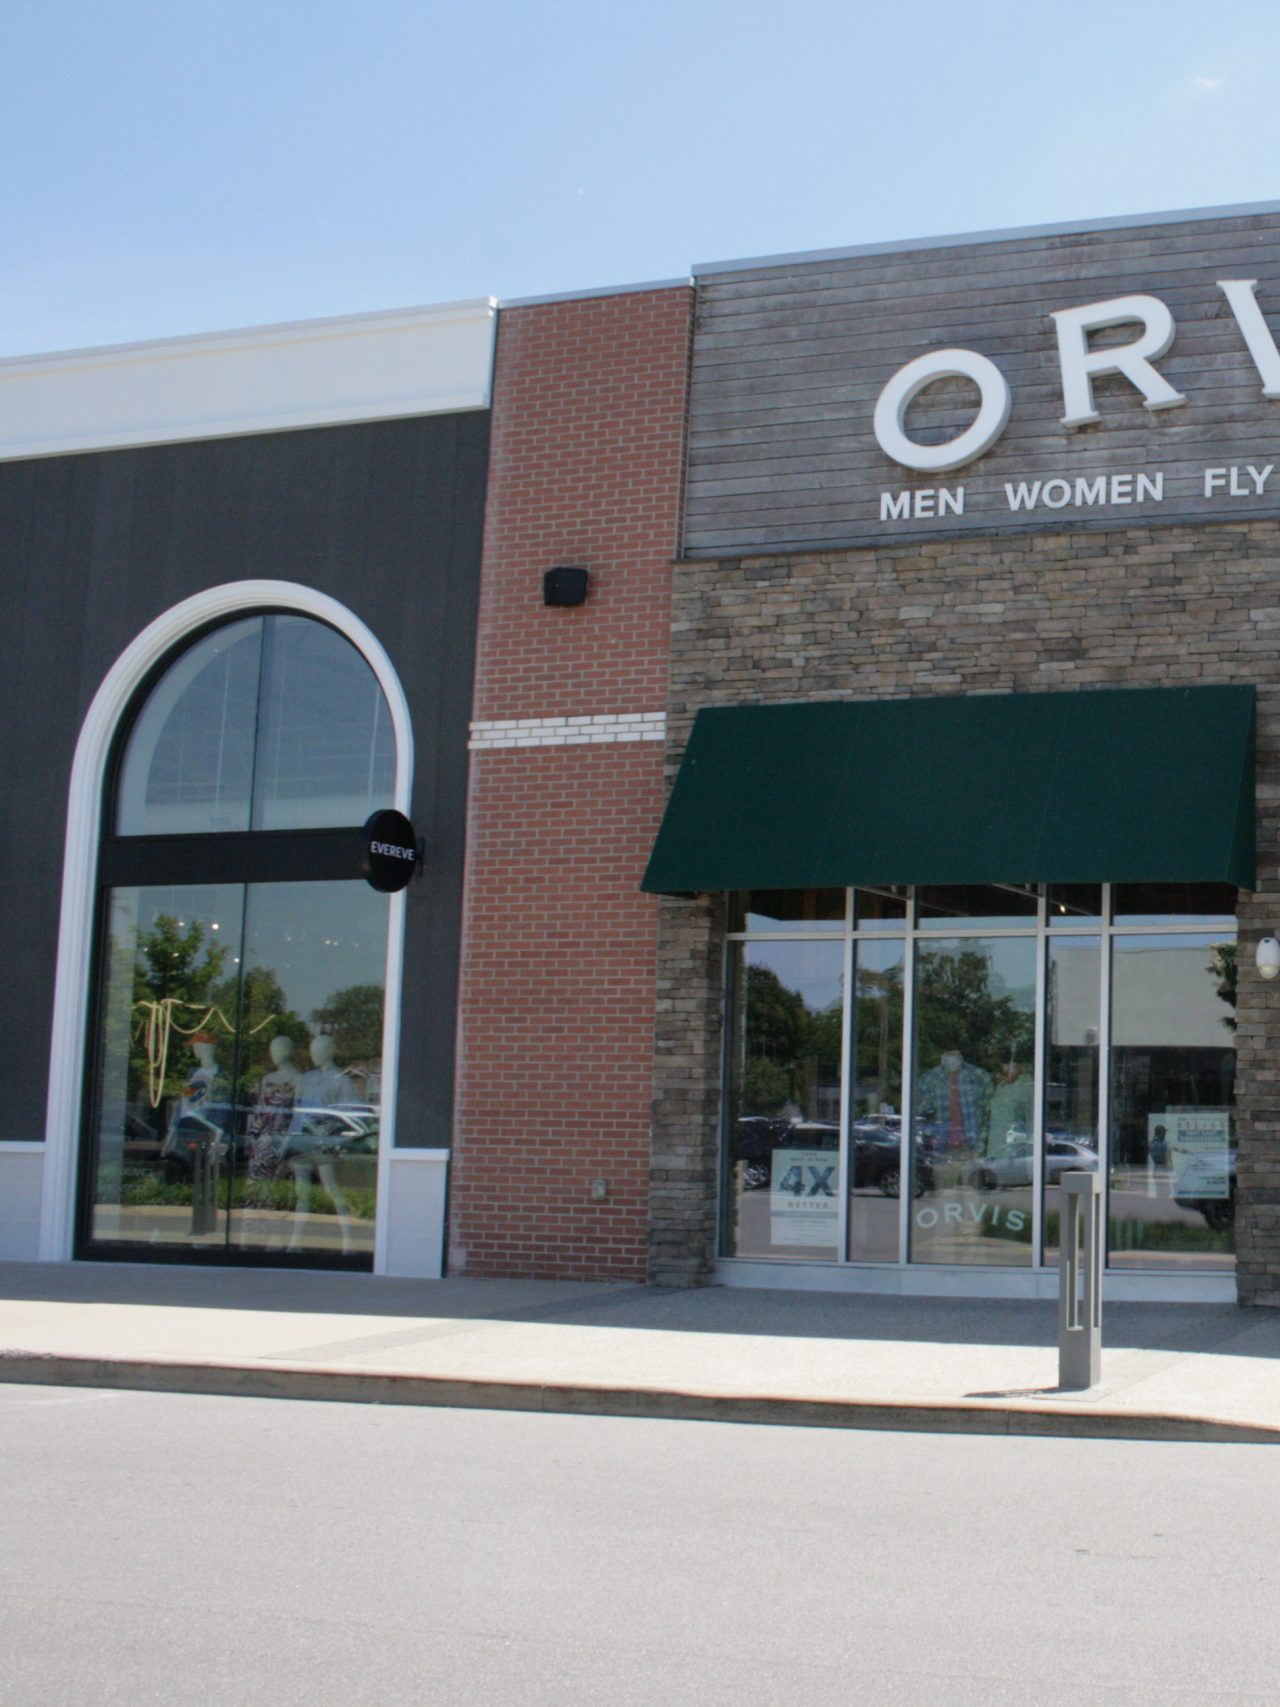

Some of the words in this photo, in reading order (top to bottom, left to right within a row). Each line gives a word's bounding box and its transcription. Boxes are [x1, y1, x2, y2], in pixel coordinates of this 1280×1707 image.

[880, 487, 964, 521] MEN
[1005, 472, 1164, 512] WOMEN
[1204, 465, 1274, 497] FLY
[370, 841, 415, 861] EVEREVE
[780, 1166, 836, 1197] 4X
[916, 1203, 1026, 1232] ORVIS
